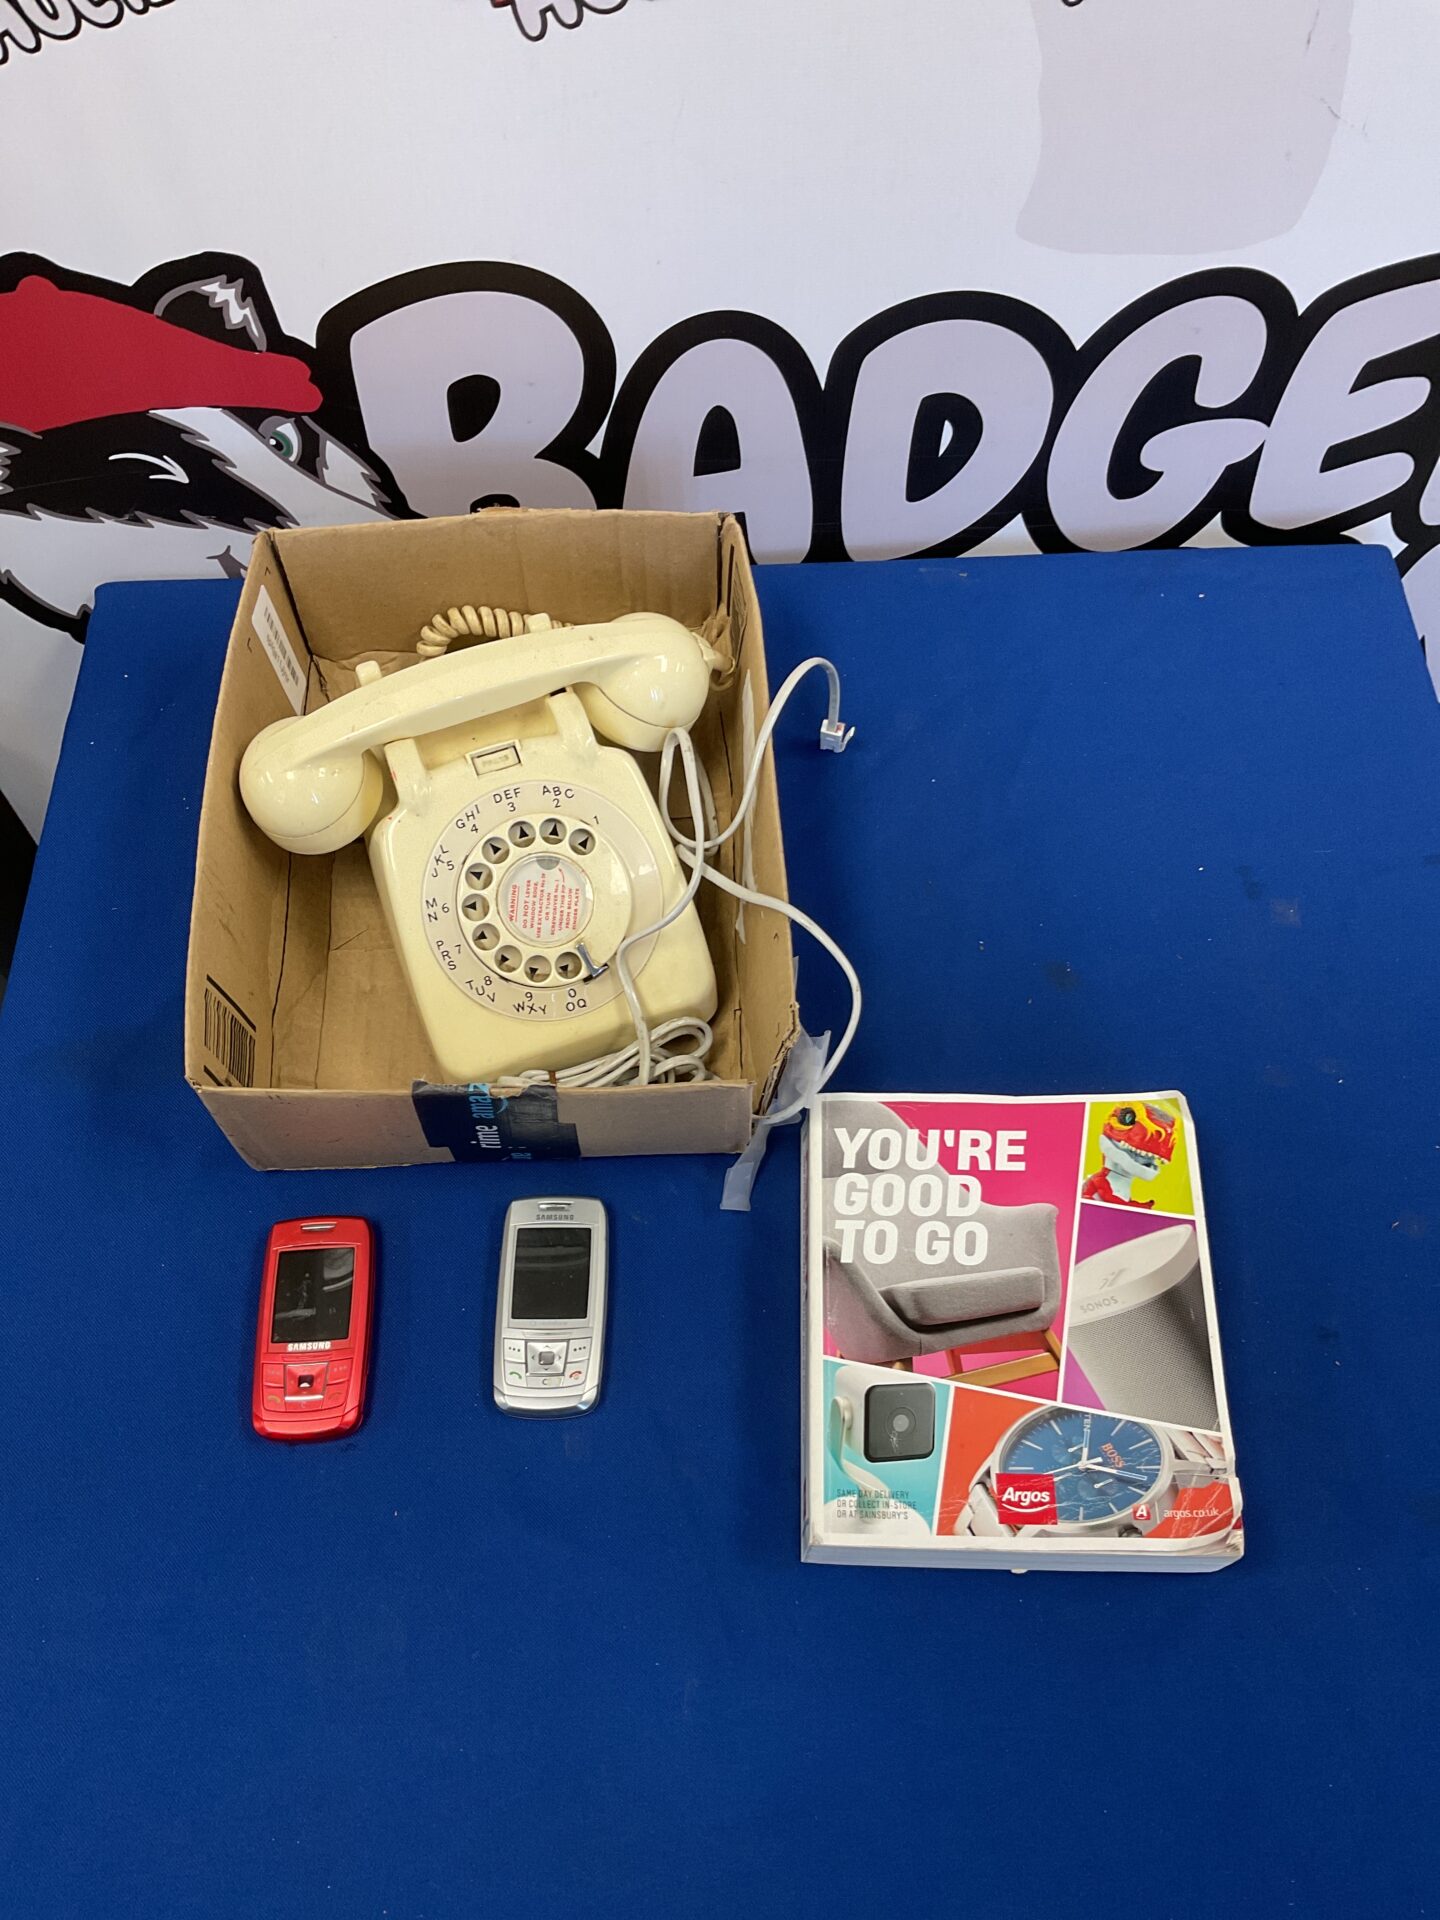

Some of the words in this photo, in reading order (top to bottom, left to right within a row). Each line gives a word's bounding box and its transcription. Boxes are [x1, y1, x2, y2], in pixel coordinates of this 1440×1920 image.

[316, 254, 1440, 565] BADGE
[493, 787, 521, 804] DEF
[542, 785, 575, 799] ABC
[508, 802, 516, 812] 3
[553, 799, 561, 809] 2
[455, 804, 481, 829] GHI
[593, 815, 601, 825] 1
[470, 823, 479, 834] 4
[431, 845, 449, 878] JKL
[446, 861, 454, 871] 5
[441, 903, 450, 913] 6
[508, 884, 517, 921] WARNING
[425, 898, 438, 922] MN
[545, 912, 549, 920] OR
[435, 940, 457, 971] PRS
[454, 944, 462, 954] 7
[484, 976, 492, 986] 8
[465, 979, 496, 1003] TUV
[525, 991, 533, 1002] 9
[513, 1002, 547, 1015] WXY
[566, 998, 587, 1012] OQ
[834, 1128, 1027, 1171] YOU'RE
[834, 1173, 981, 1216] GOOD
[835, 1220, 898, 1264] TO
[915, 1221, 988, 1265] GO
[1080, 1296, 1119, 1313] SONOS
[287, 1341, 331, 1352] SAMSUNG
[1102, 1443, 1125, 1467] BOSS
[837, 1489, 856, 1497] SAME
[858, 1490, 872, 1498] DAY
[874, 1490, 910, 1499] DELIVERY
[1001, 1487, 1050, 1506] Argos
[837, 1499, 846, 1507] OR
[849, 1500, 879, 1508] COLLECT
[882, 1500, 917, 1509] IN-STORE
[837, 1510, 846, 1518] OR
[849, 1510, 857, 1518] AT
[859, 1511, 908, 1520] SAINSBURY'S
[1163, 1507, 1220, 1519] argos.co.uk
